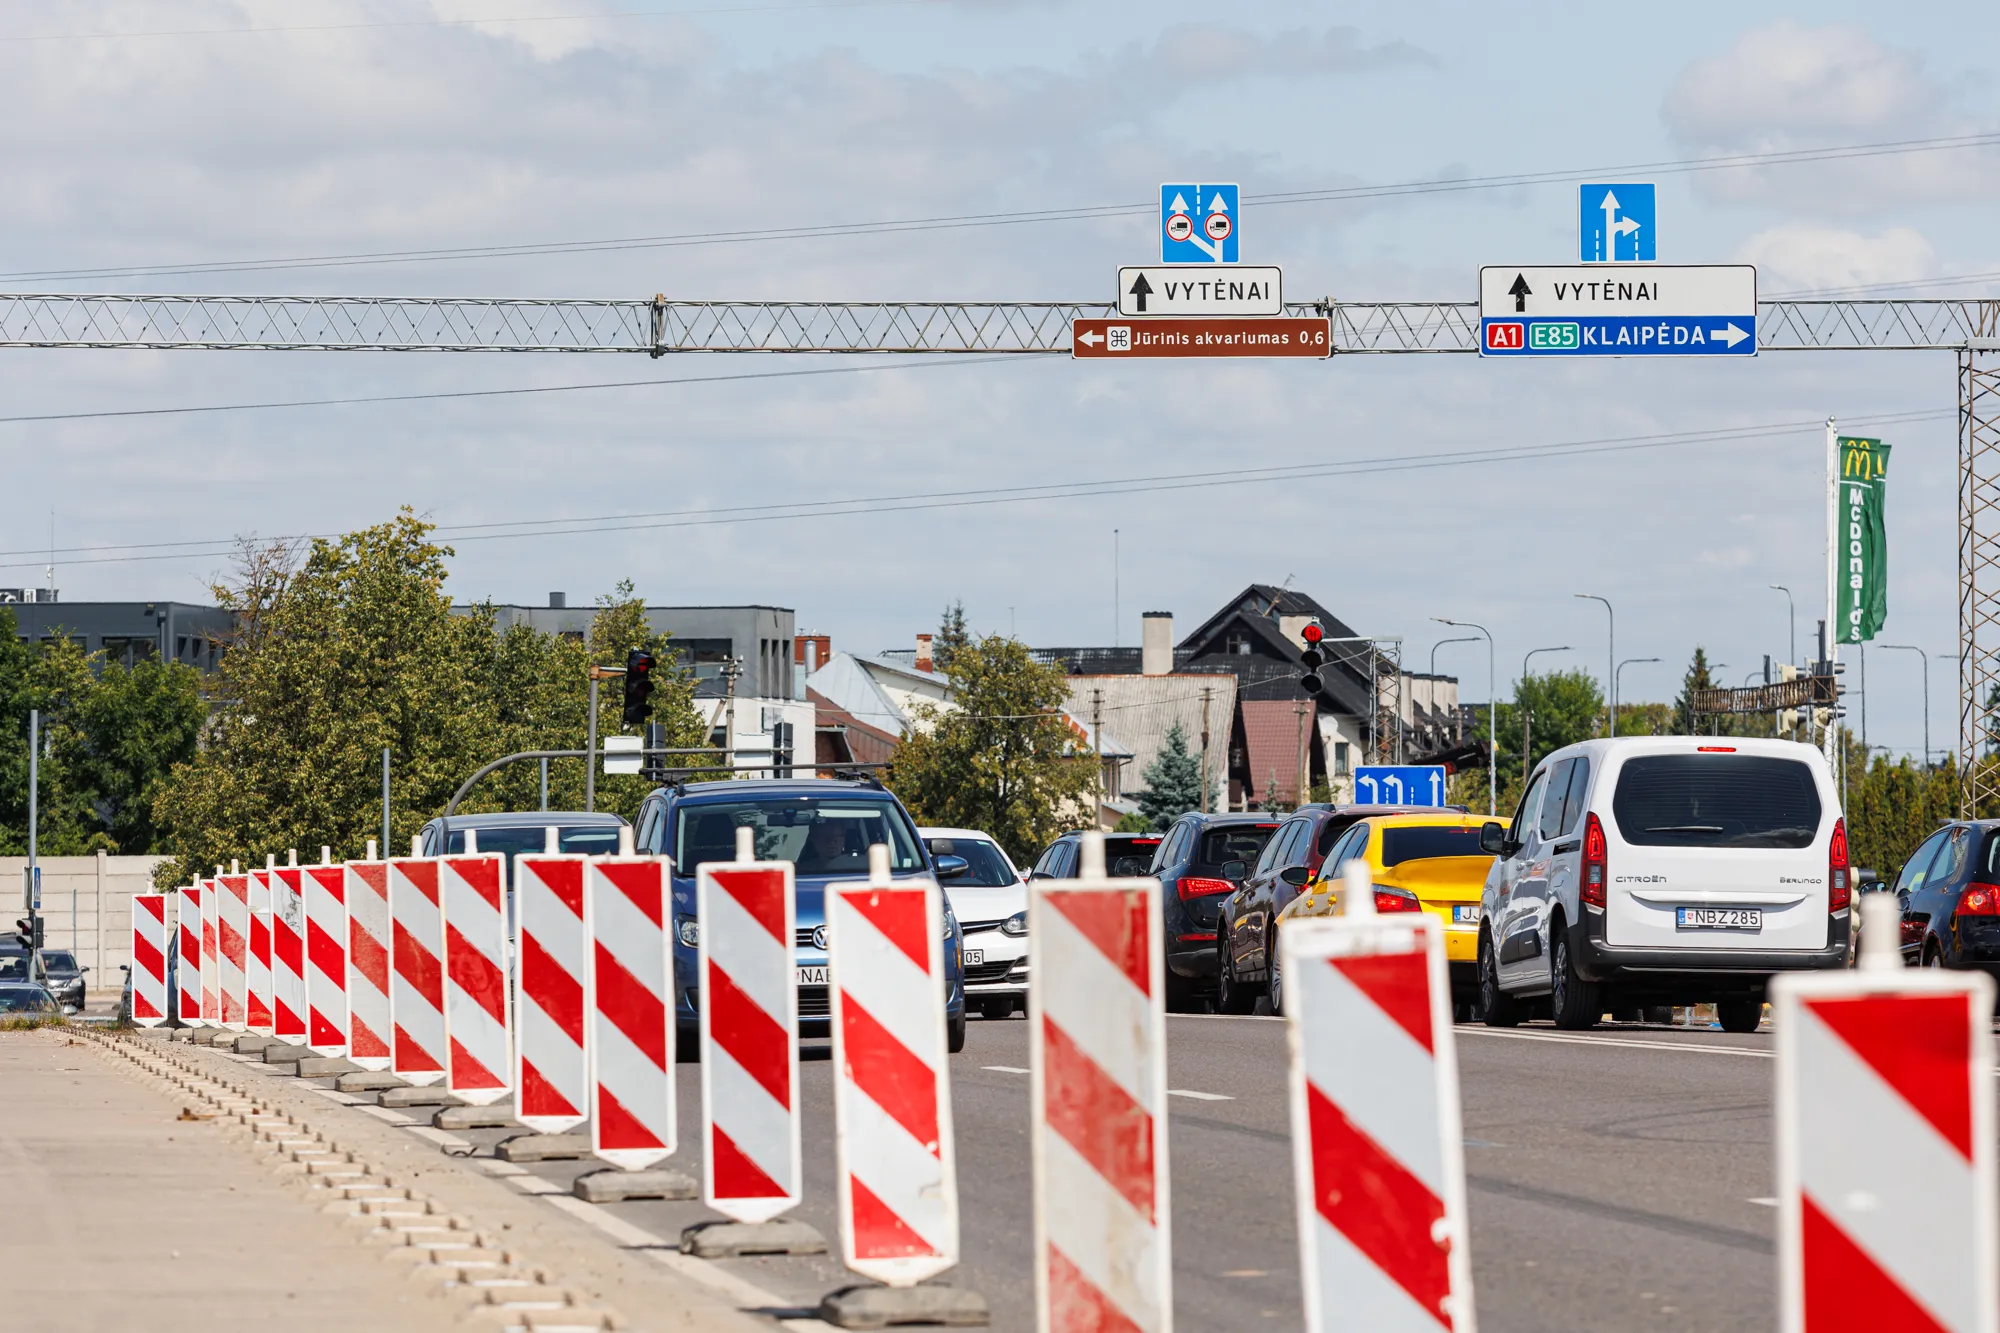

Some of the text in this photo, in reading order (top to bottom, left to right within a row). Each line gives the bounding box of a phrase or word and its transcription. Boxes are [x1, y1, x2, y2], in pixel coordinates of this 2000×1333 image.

[1164, 278, 1269, 301] VYTĖNAI
[1554, 278, 1658, 301] VYTĖNAI
[1133, 330, 1324, 347] Jūrinis akvariumas 0,6
[1493, 322, 1706, 346] A1 E85 KLAIPĖDA
